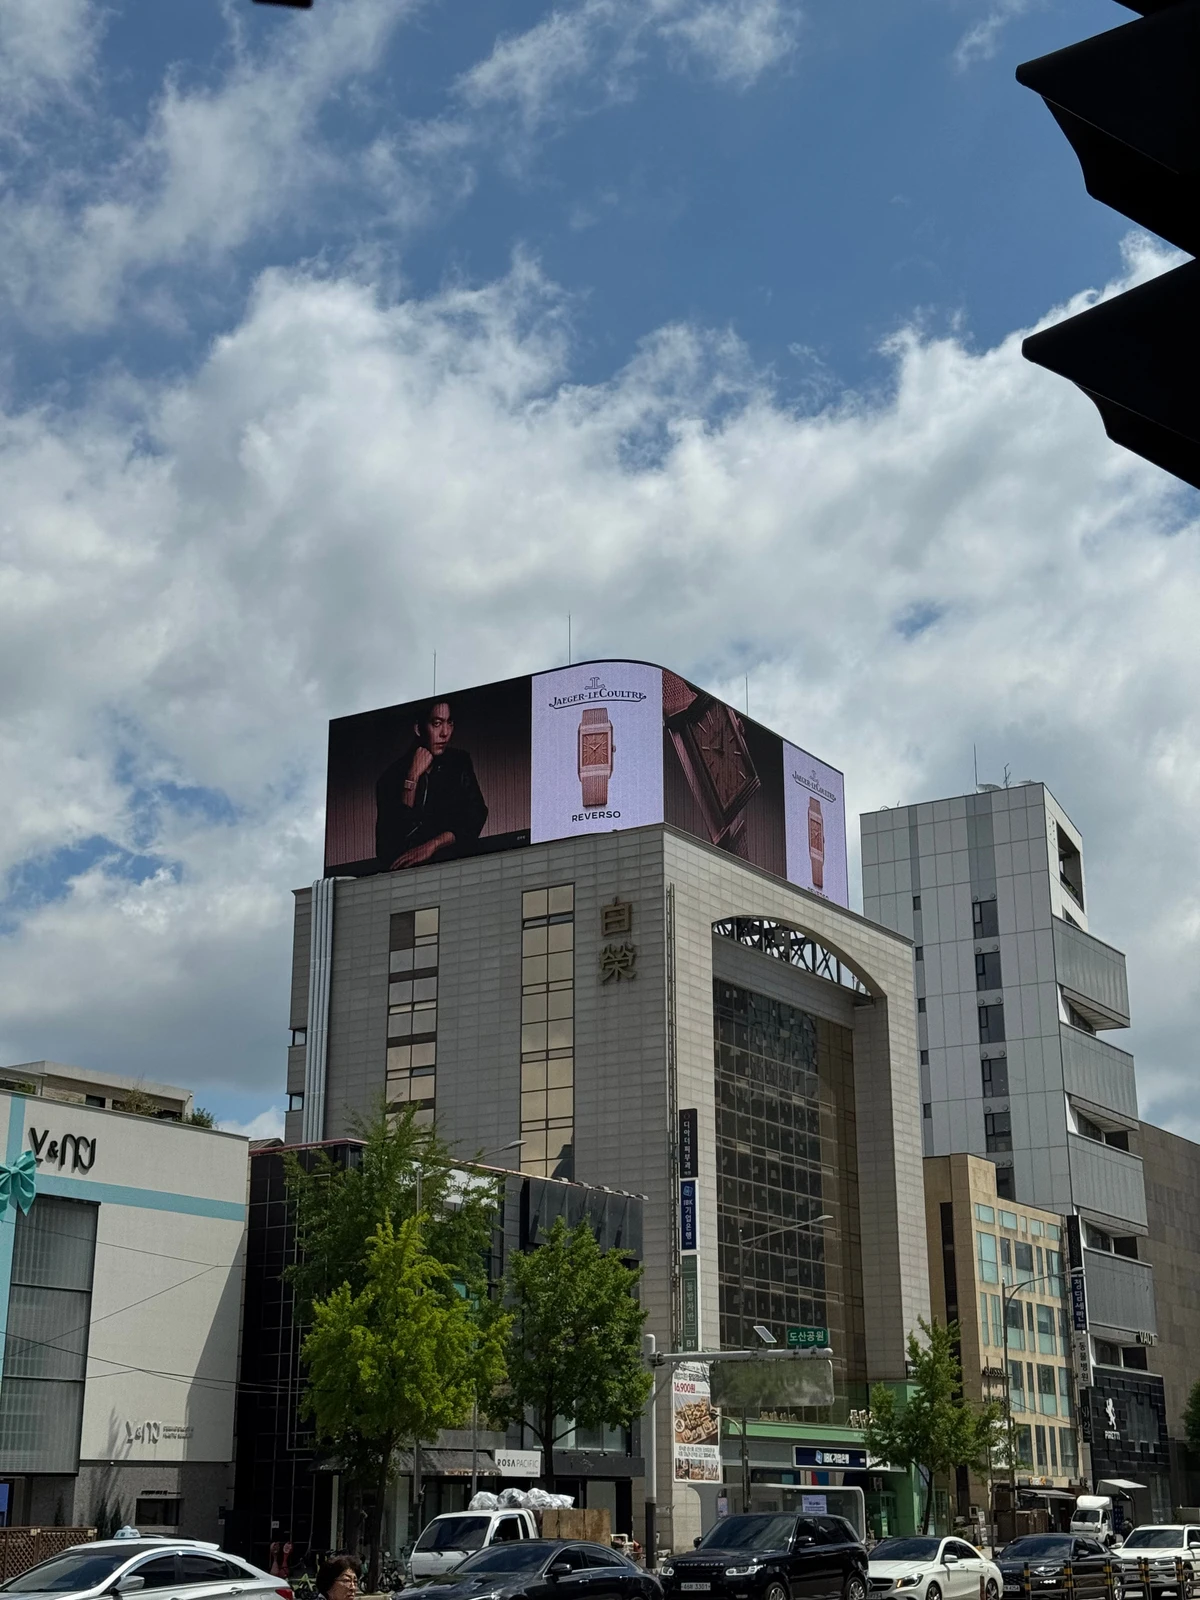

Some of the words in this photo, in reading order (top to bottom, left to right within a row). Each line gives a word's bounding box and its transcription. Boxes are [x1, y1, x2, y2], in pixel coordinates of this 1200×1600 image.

[571, 810, 621, 823] REVERSO
[789, 1330, 825, 1342] 도산공원
[686, 1339, 695, 1348] B1
[1079, 1341, 1089, 1382] 동물병원
